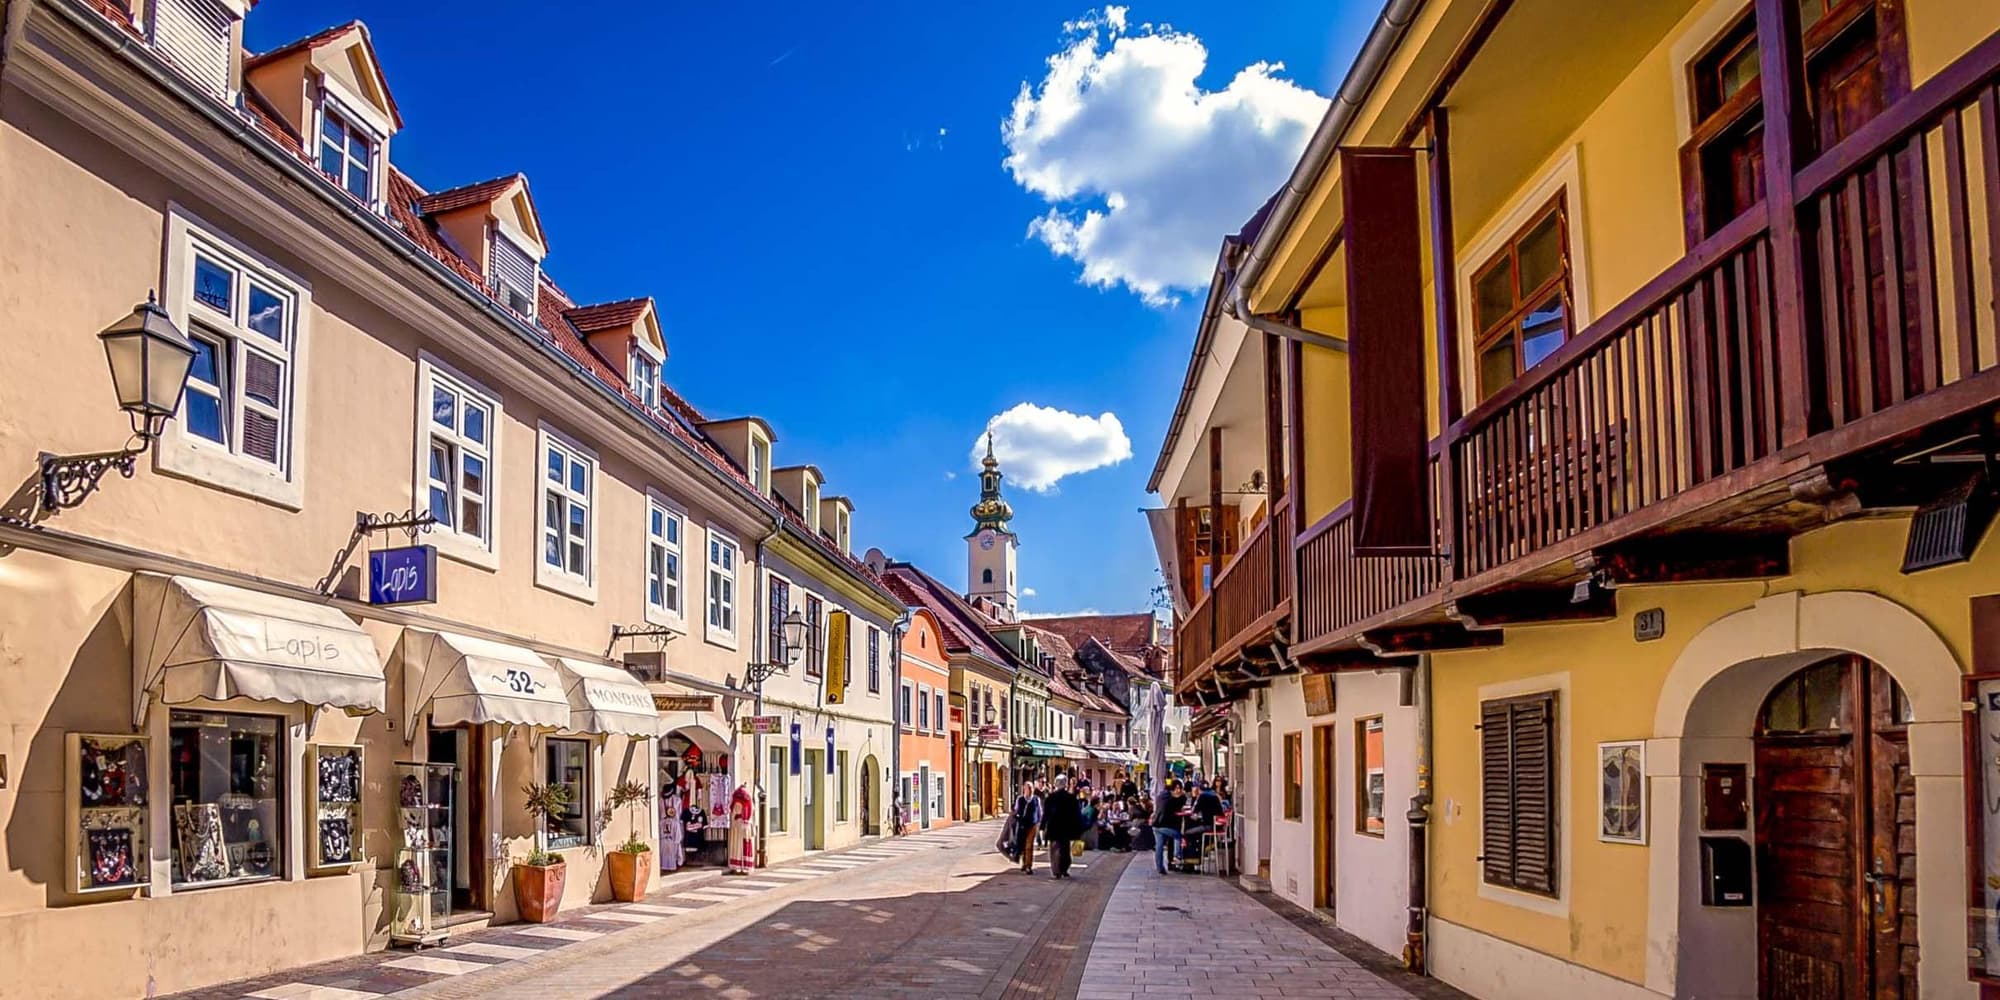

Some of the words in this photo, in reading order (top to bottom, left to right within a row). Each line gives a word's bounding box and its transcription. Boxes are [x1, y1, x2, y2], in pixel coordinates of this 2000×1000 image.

[380, 552, 418, 601] Lapis
[1639, 612, 1654, 631] 31
[263, 618, 340, 664] Lapis
[592, 687, 651, 708] MONDAYS
